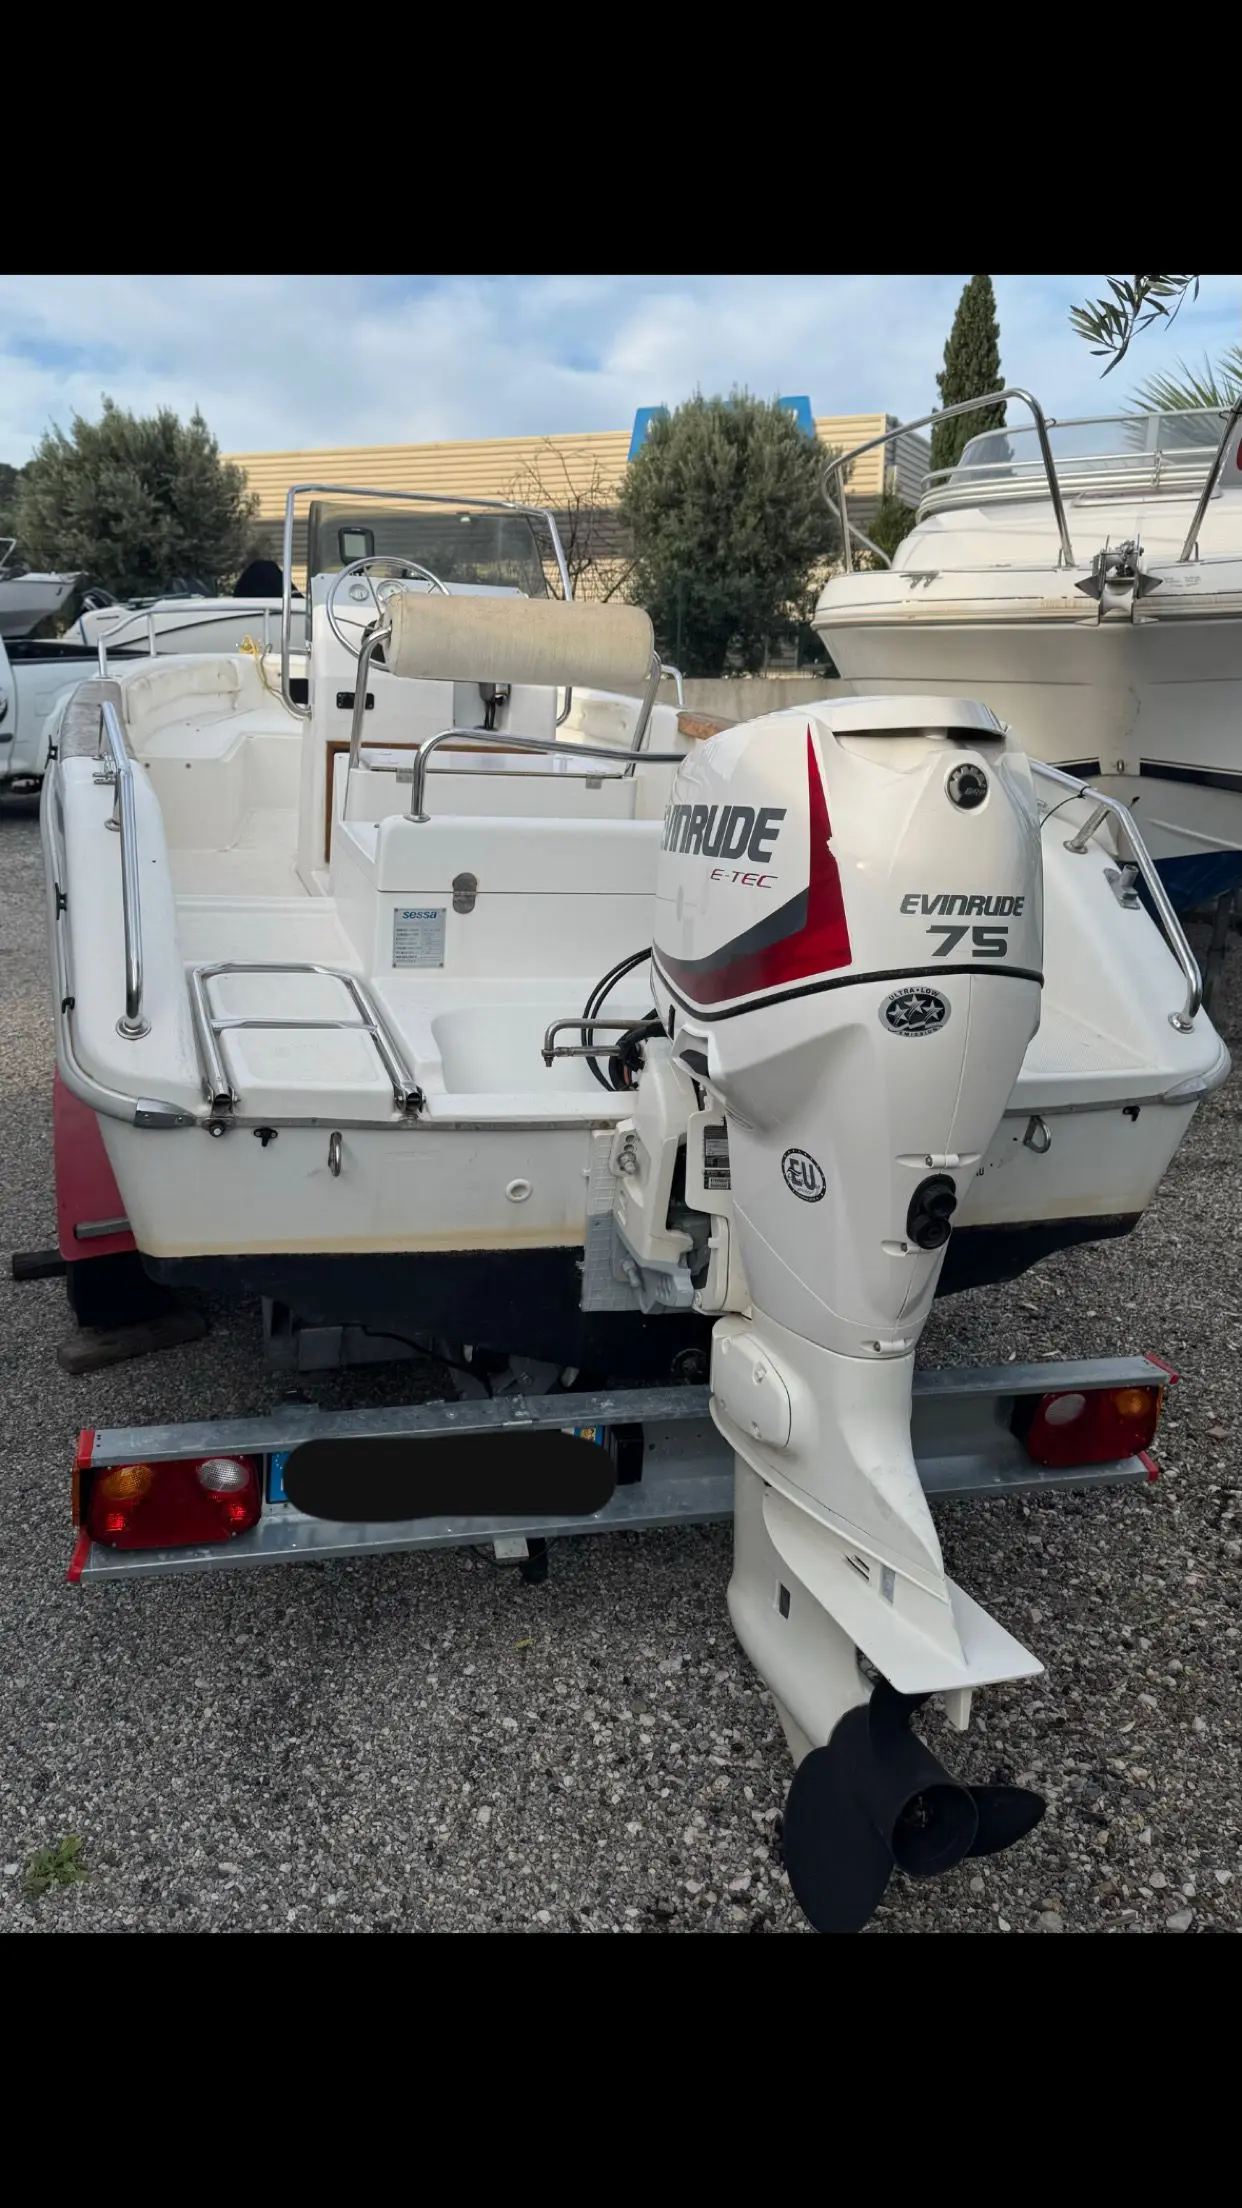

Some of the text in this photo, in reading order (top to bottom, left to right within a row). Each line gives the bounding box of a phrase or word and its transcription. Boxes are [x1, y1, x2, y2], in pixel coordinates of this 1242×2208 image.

[710, 868, 779, 888] E-TEC
[402, 911, 437, 919] sessa
[899, 893, 1025, 917] EVINRUDE
[925, 924, 1009, 957] 75
[789, 1157, 816, 1191] EU
